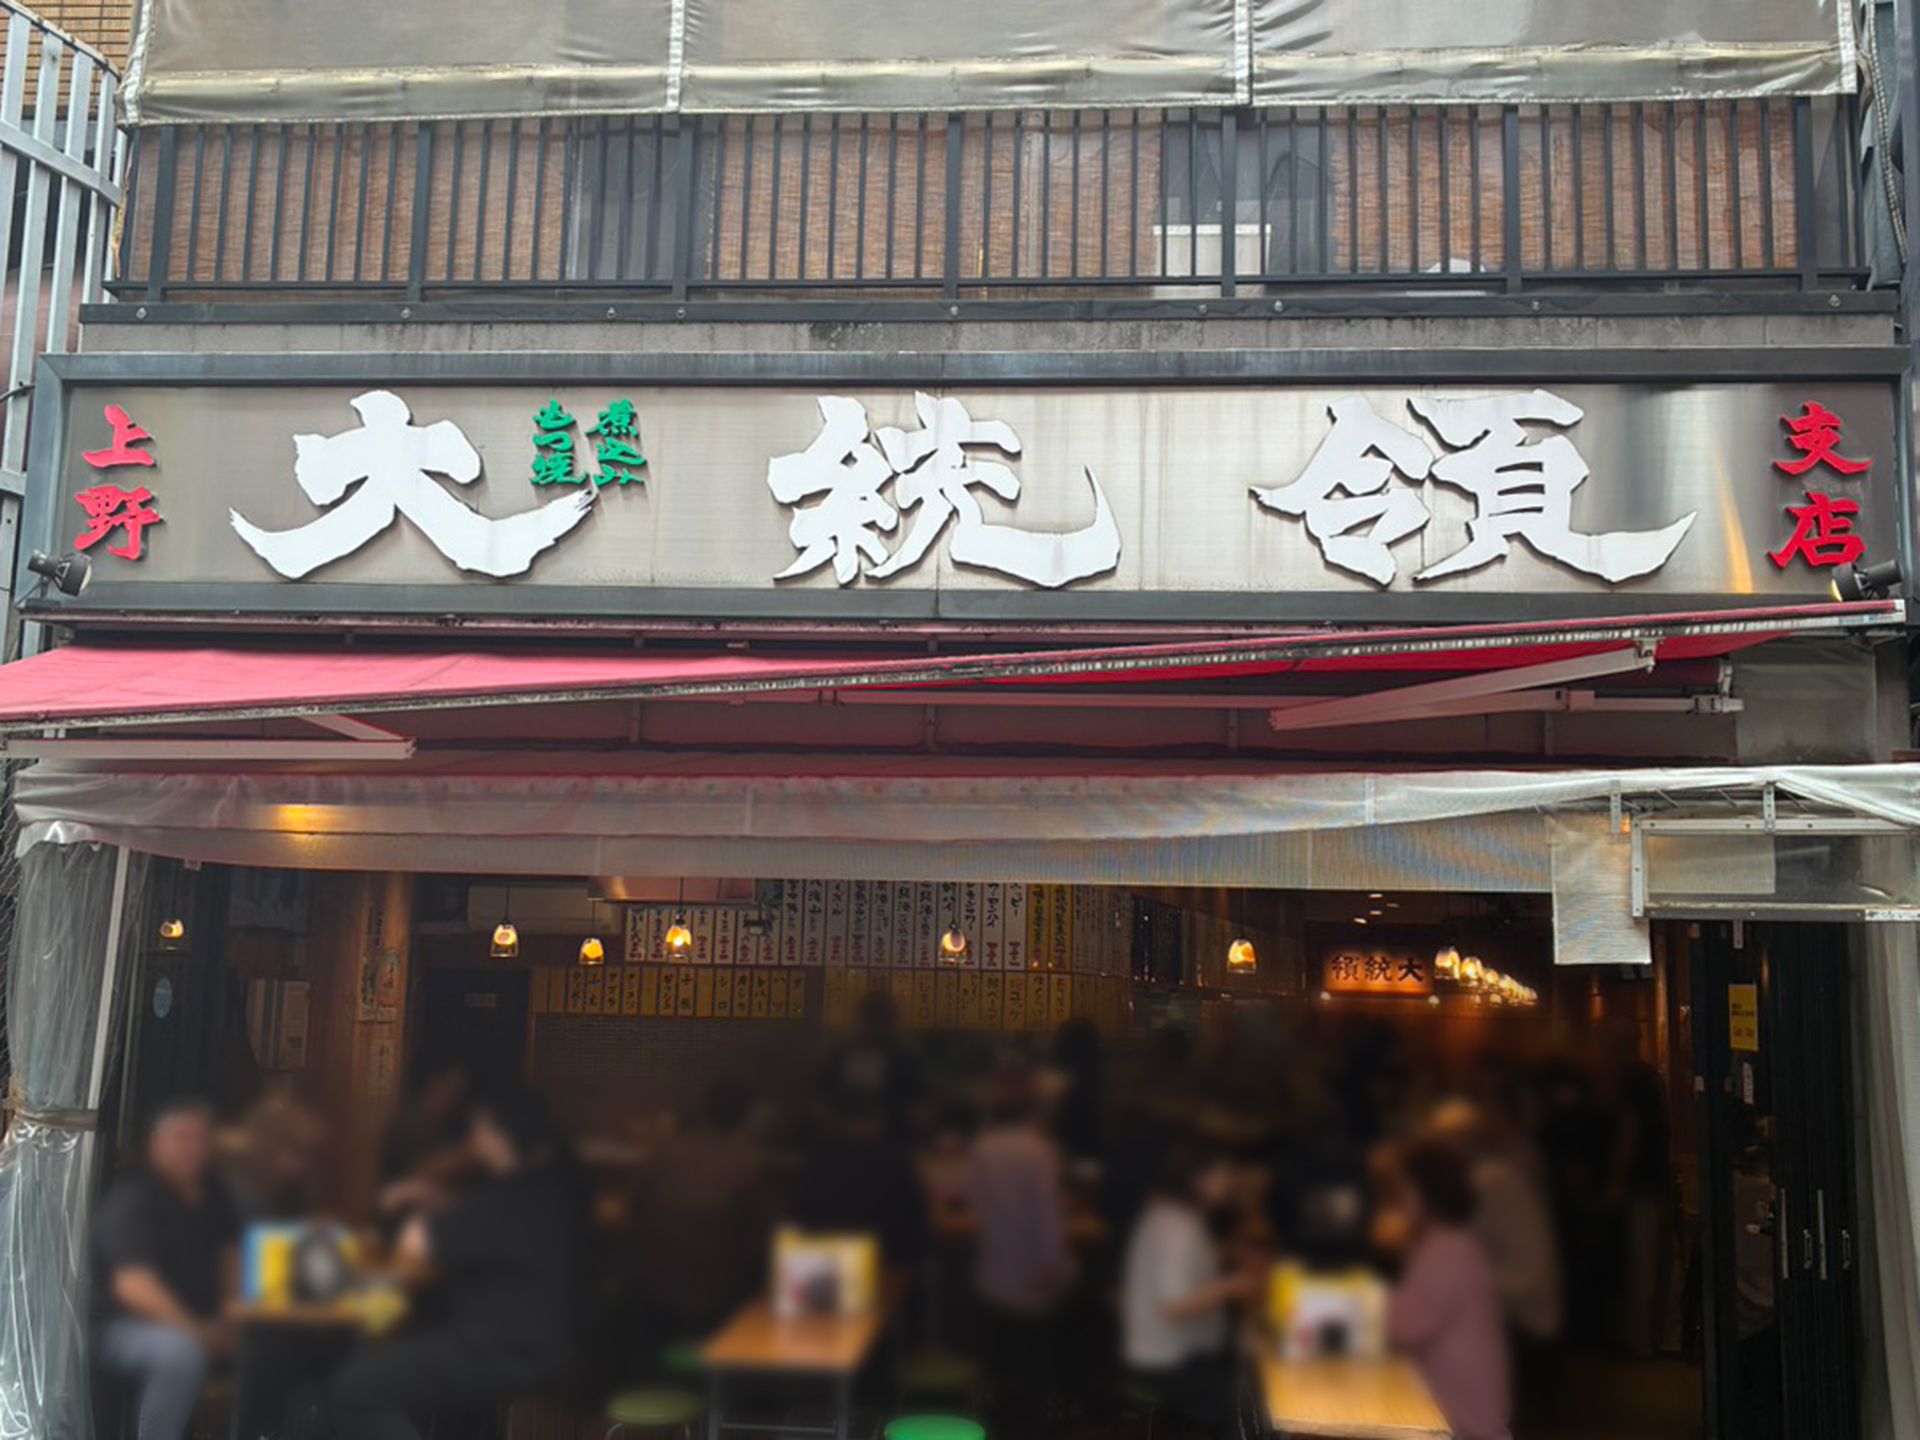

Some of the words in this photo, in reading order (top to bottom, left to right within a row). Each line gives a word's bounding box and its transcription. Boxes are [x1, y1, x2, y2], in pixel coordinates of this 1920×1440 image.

[74, 404, 163, 561] 上野
[230, 388, 1697, 590] 大統領
[1768, 402, 1872, 569] 支店
